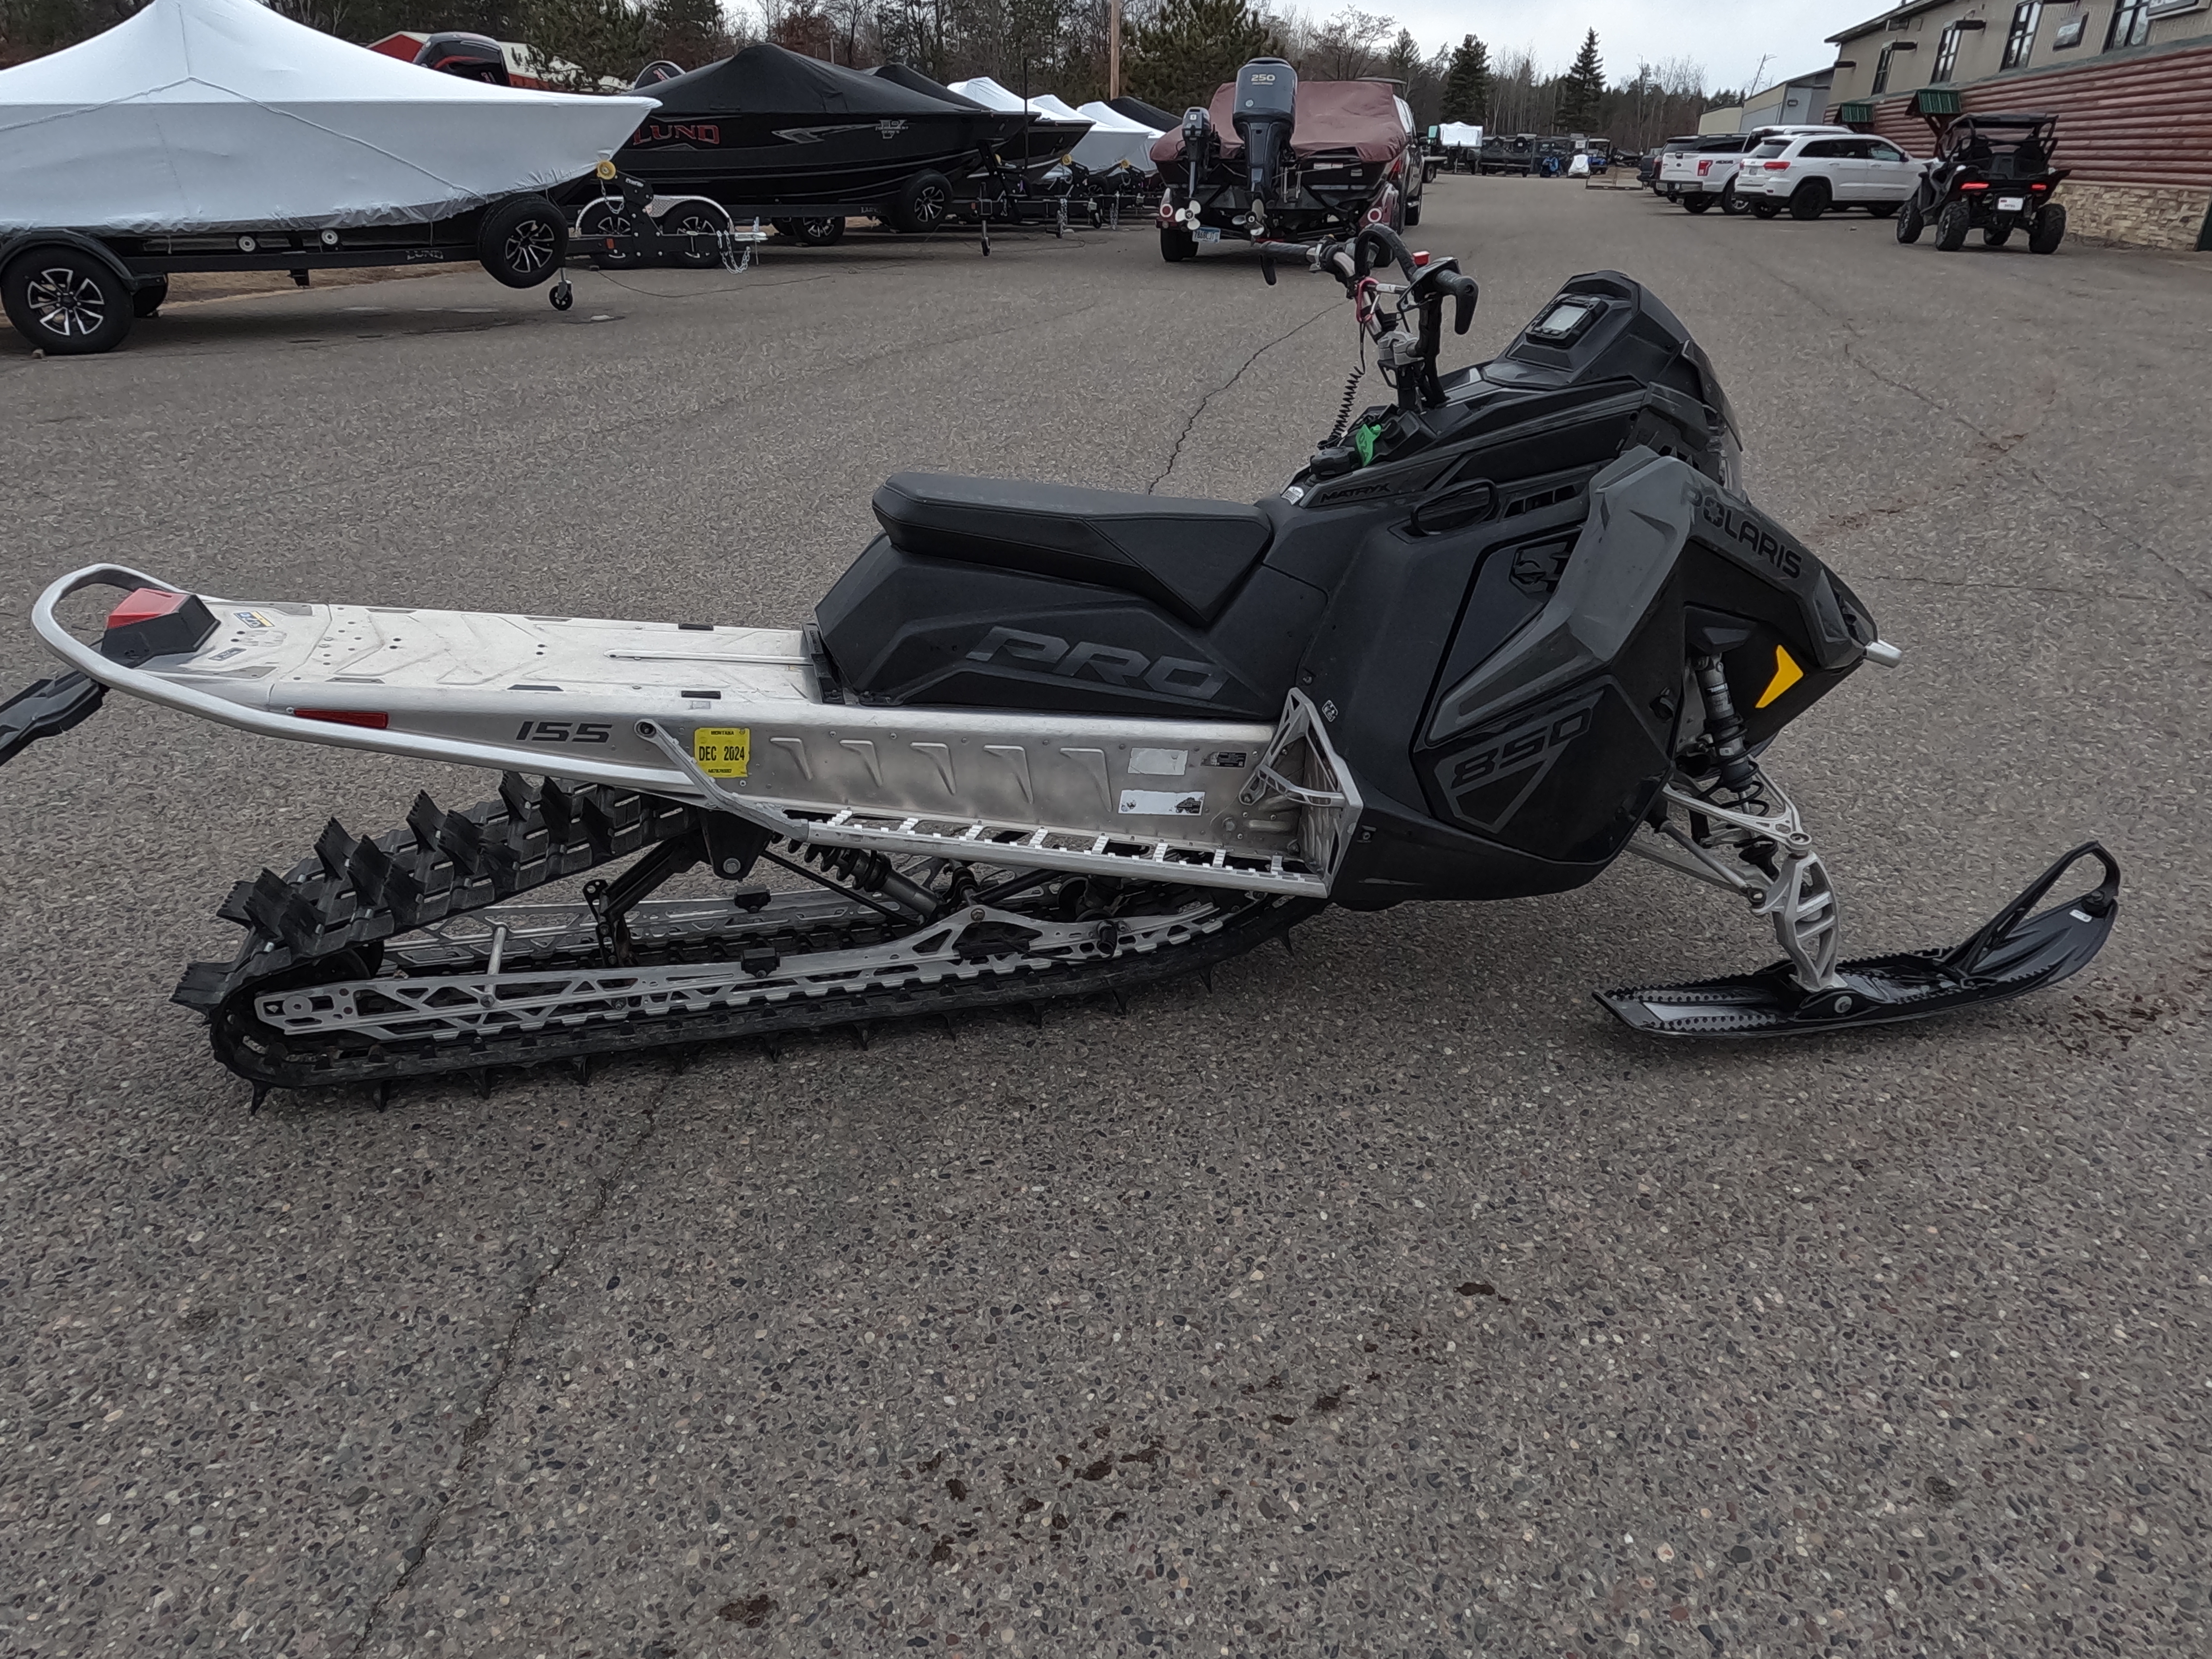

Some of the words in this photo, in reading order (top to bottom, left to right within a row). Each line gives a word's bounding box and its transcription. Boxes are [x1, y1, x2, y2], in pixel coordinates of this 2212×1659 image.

[633, 125, 720, 146] LUND
[1320, 483, 1390, 503] MATRYX
[1680, 483, 1802, 579] POLARIS
[965, 626, 1230, 700] PRO
[516, 721, 612, 743] 155
[699, 746, 716, 761] DEC
[724, 746, 744, 761] 2024
[1450, 707, 1591, 789] 850
